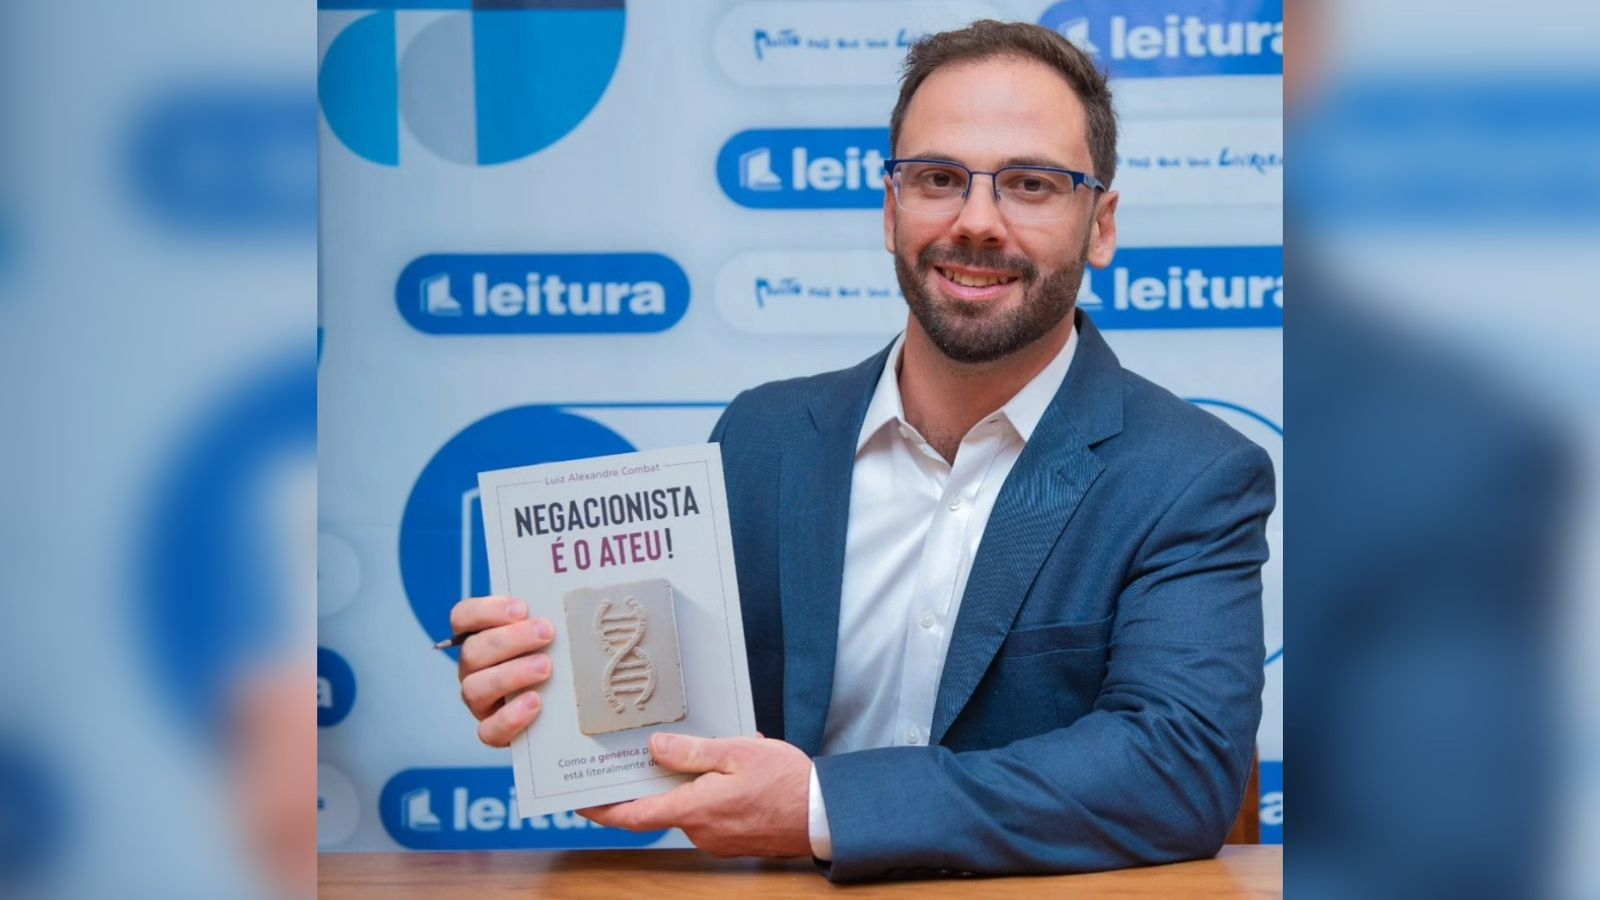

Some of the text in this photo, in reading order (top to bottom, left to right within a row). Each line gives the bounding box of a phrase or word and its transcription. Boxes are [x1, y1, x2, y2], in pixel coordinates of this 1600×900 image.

[792, 146, 885, 191] leit
[473, 272, 666, 316] leitura
[544, 463, 661, 486] Luiz Alexandre Combat
[514, 485, 700, 538] NEGACIONISTA
[551, 536, 568, 574] É
[574, 539, 591, 571] O
[558, 756, 587, 768] Como
[589, 755, 596, 764] a
[598, 747, 640, 763] genética
[563, 769, 584, 781] está
[586, 760, 648, 777] literalmente
